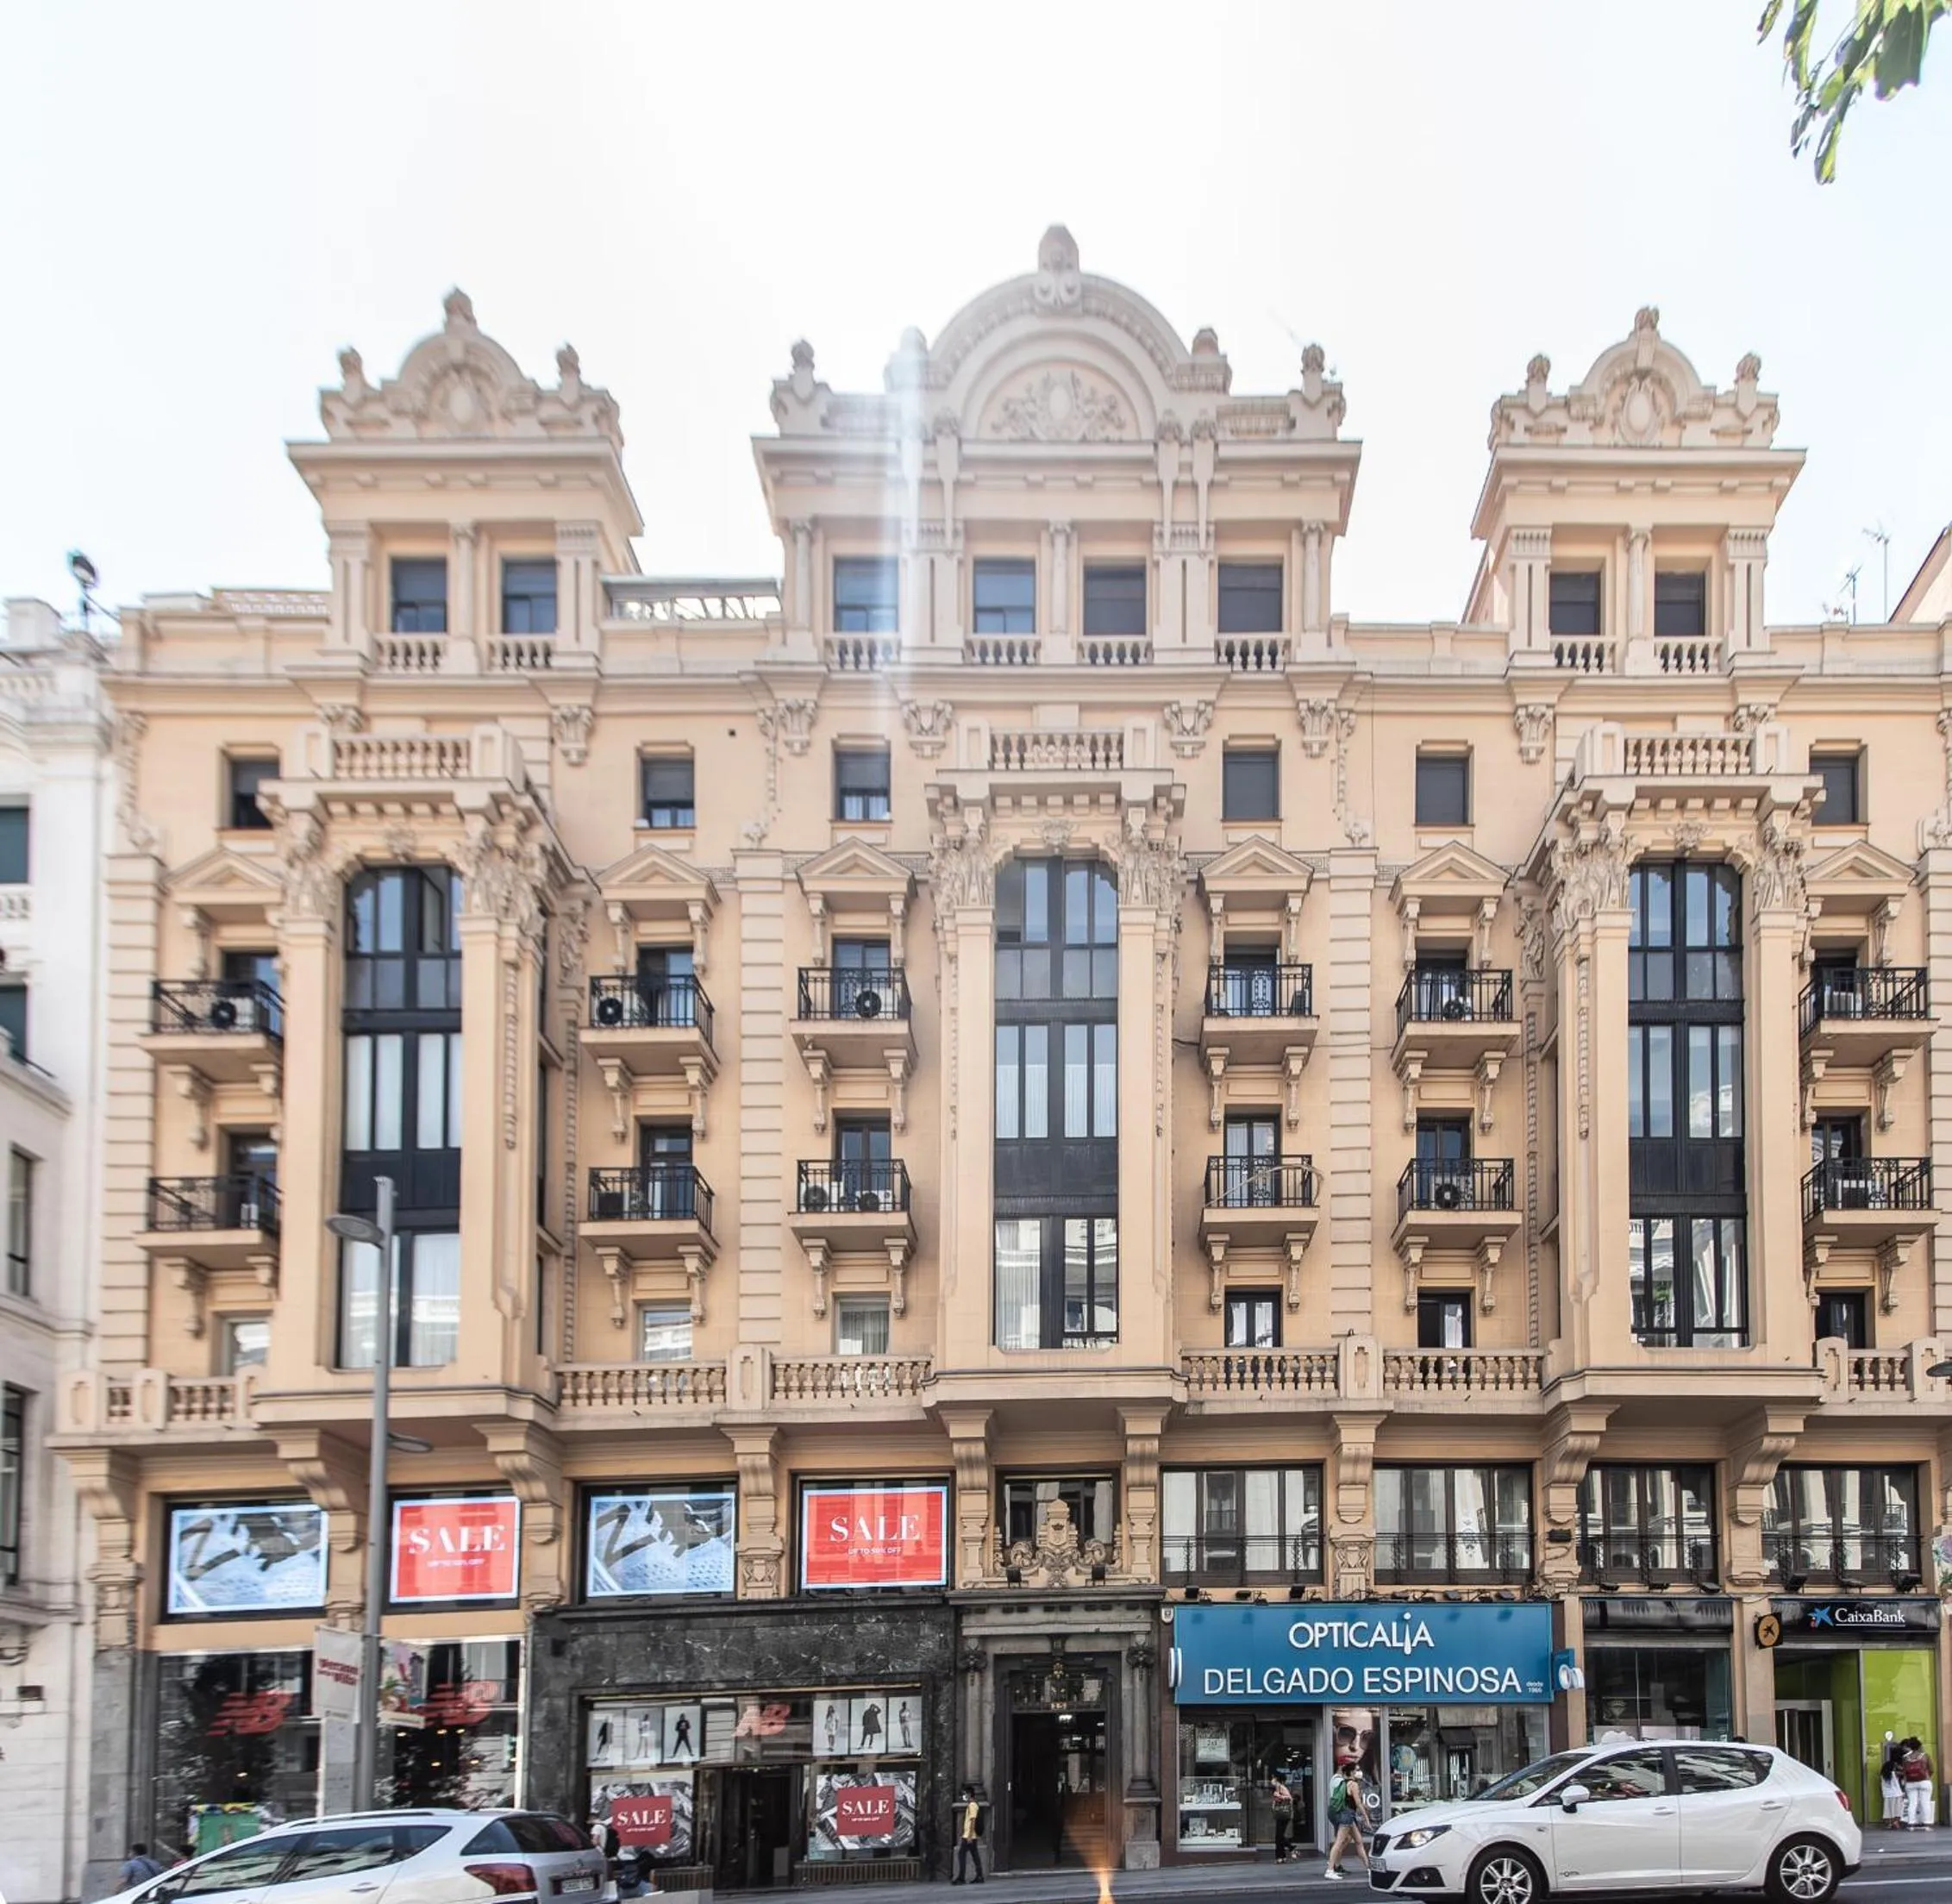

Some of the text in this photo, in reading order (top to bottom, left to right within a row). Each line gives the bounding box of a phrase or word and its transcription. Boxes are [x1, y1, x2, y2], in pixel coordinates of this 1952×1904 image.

[829, 1514, 921, 1542] SALE
[409, 1525, 506, 1554] SALE
[1835, 1607, 1905, 1623] CaixaBank
[1204, 1666, 1522, 1694] DELGADO ESPINOSA
[616, 1809, 666, 1826] SALE
[841, 1800, 890, 1815] SALE
